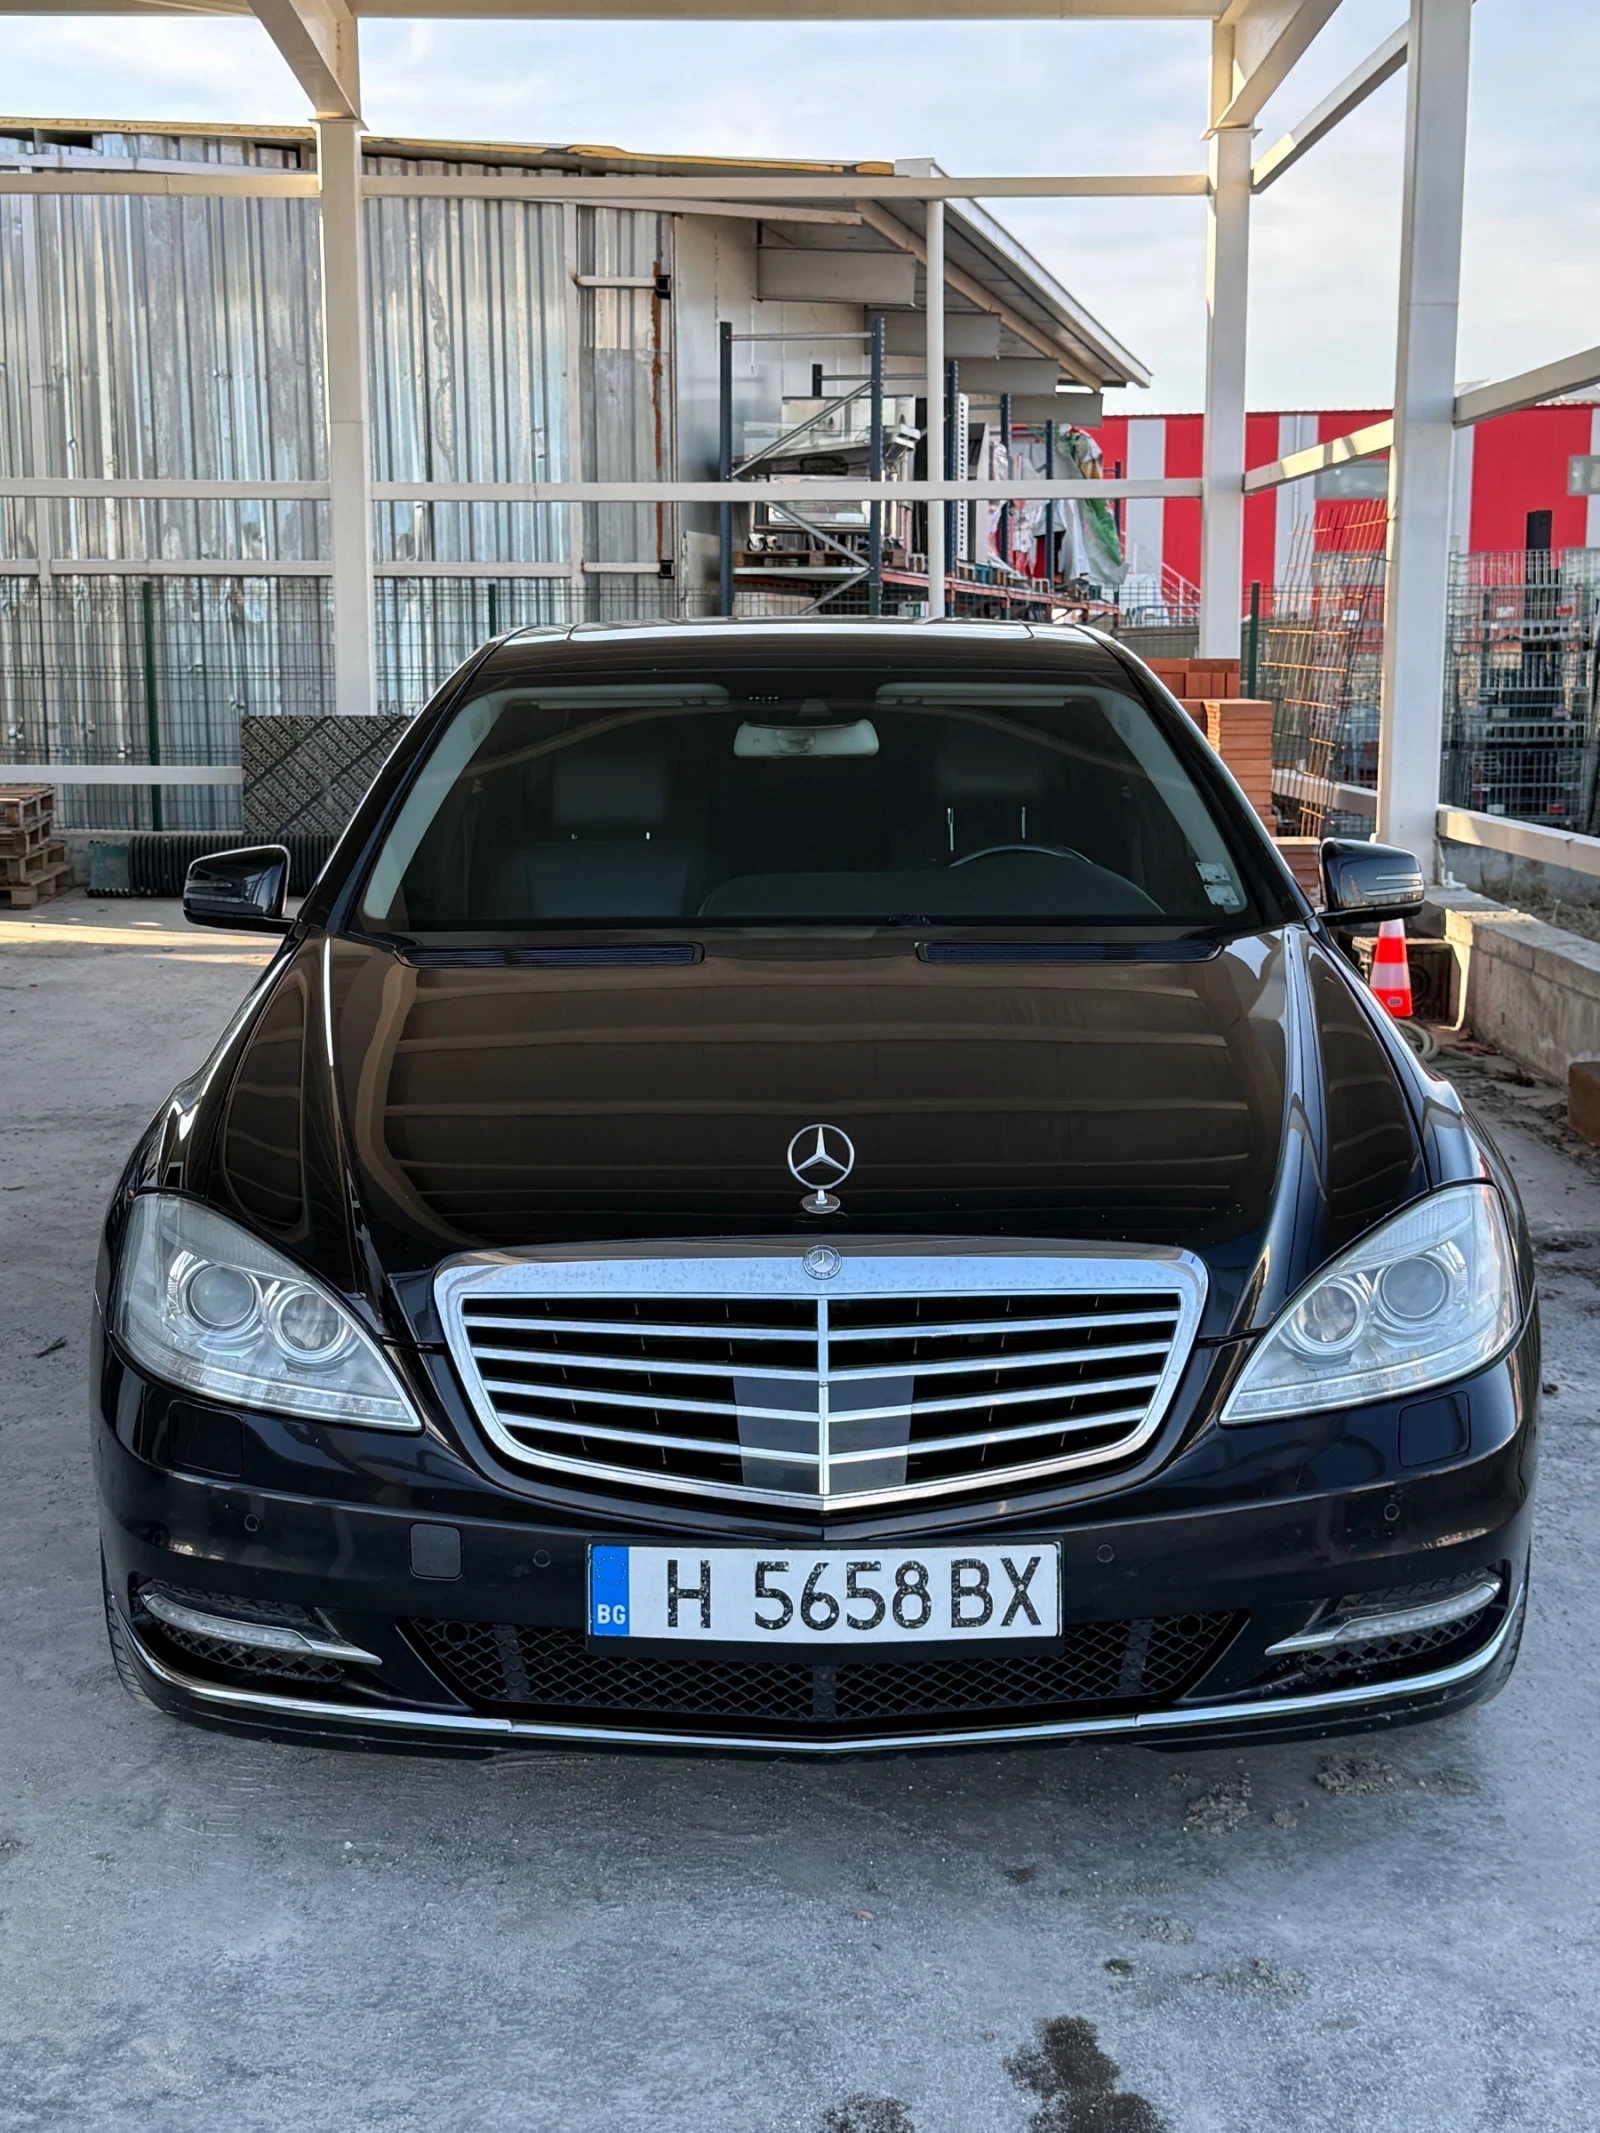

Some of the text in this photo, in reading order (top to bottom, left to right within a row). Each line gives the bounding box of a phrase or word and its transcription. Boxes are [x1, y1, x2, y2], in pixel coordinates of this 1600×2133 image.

[313, 729, 351, 766] FENOLICO
[322, 719, 361, 756] FENOLICO
[262, 774, 301, 811] FENOLICO
[282, 756, 321, 793] FENOLICO
[667, 1556, 1042, 1631] H 5658 BX
[597, 1604, 626, 1625] BG
